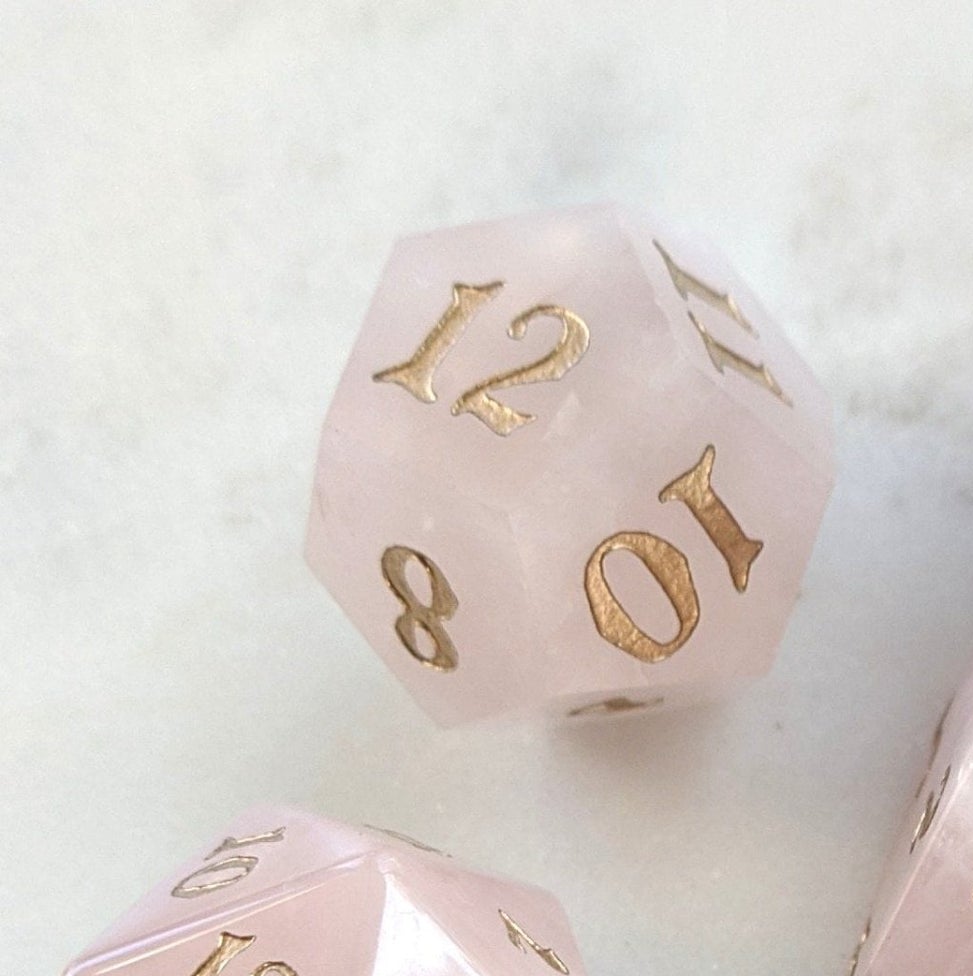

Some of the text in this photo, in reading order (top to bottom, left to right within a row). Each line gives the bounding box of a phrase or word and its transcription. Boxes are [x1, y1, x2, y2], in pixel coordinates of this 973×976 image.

[372, 281, 590, 437] 12
[653, 239, 793, 407] 11
[381, 545, 459, 673] 8
[584, 444, 763, 664] 10
[170, 826, 286, 898] 10
